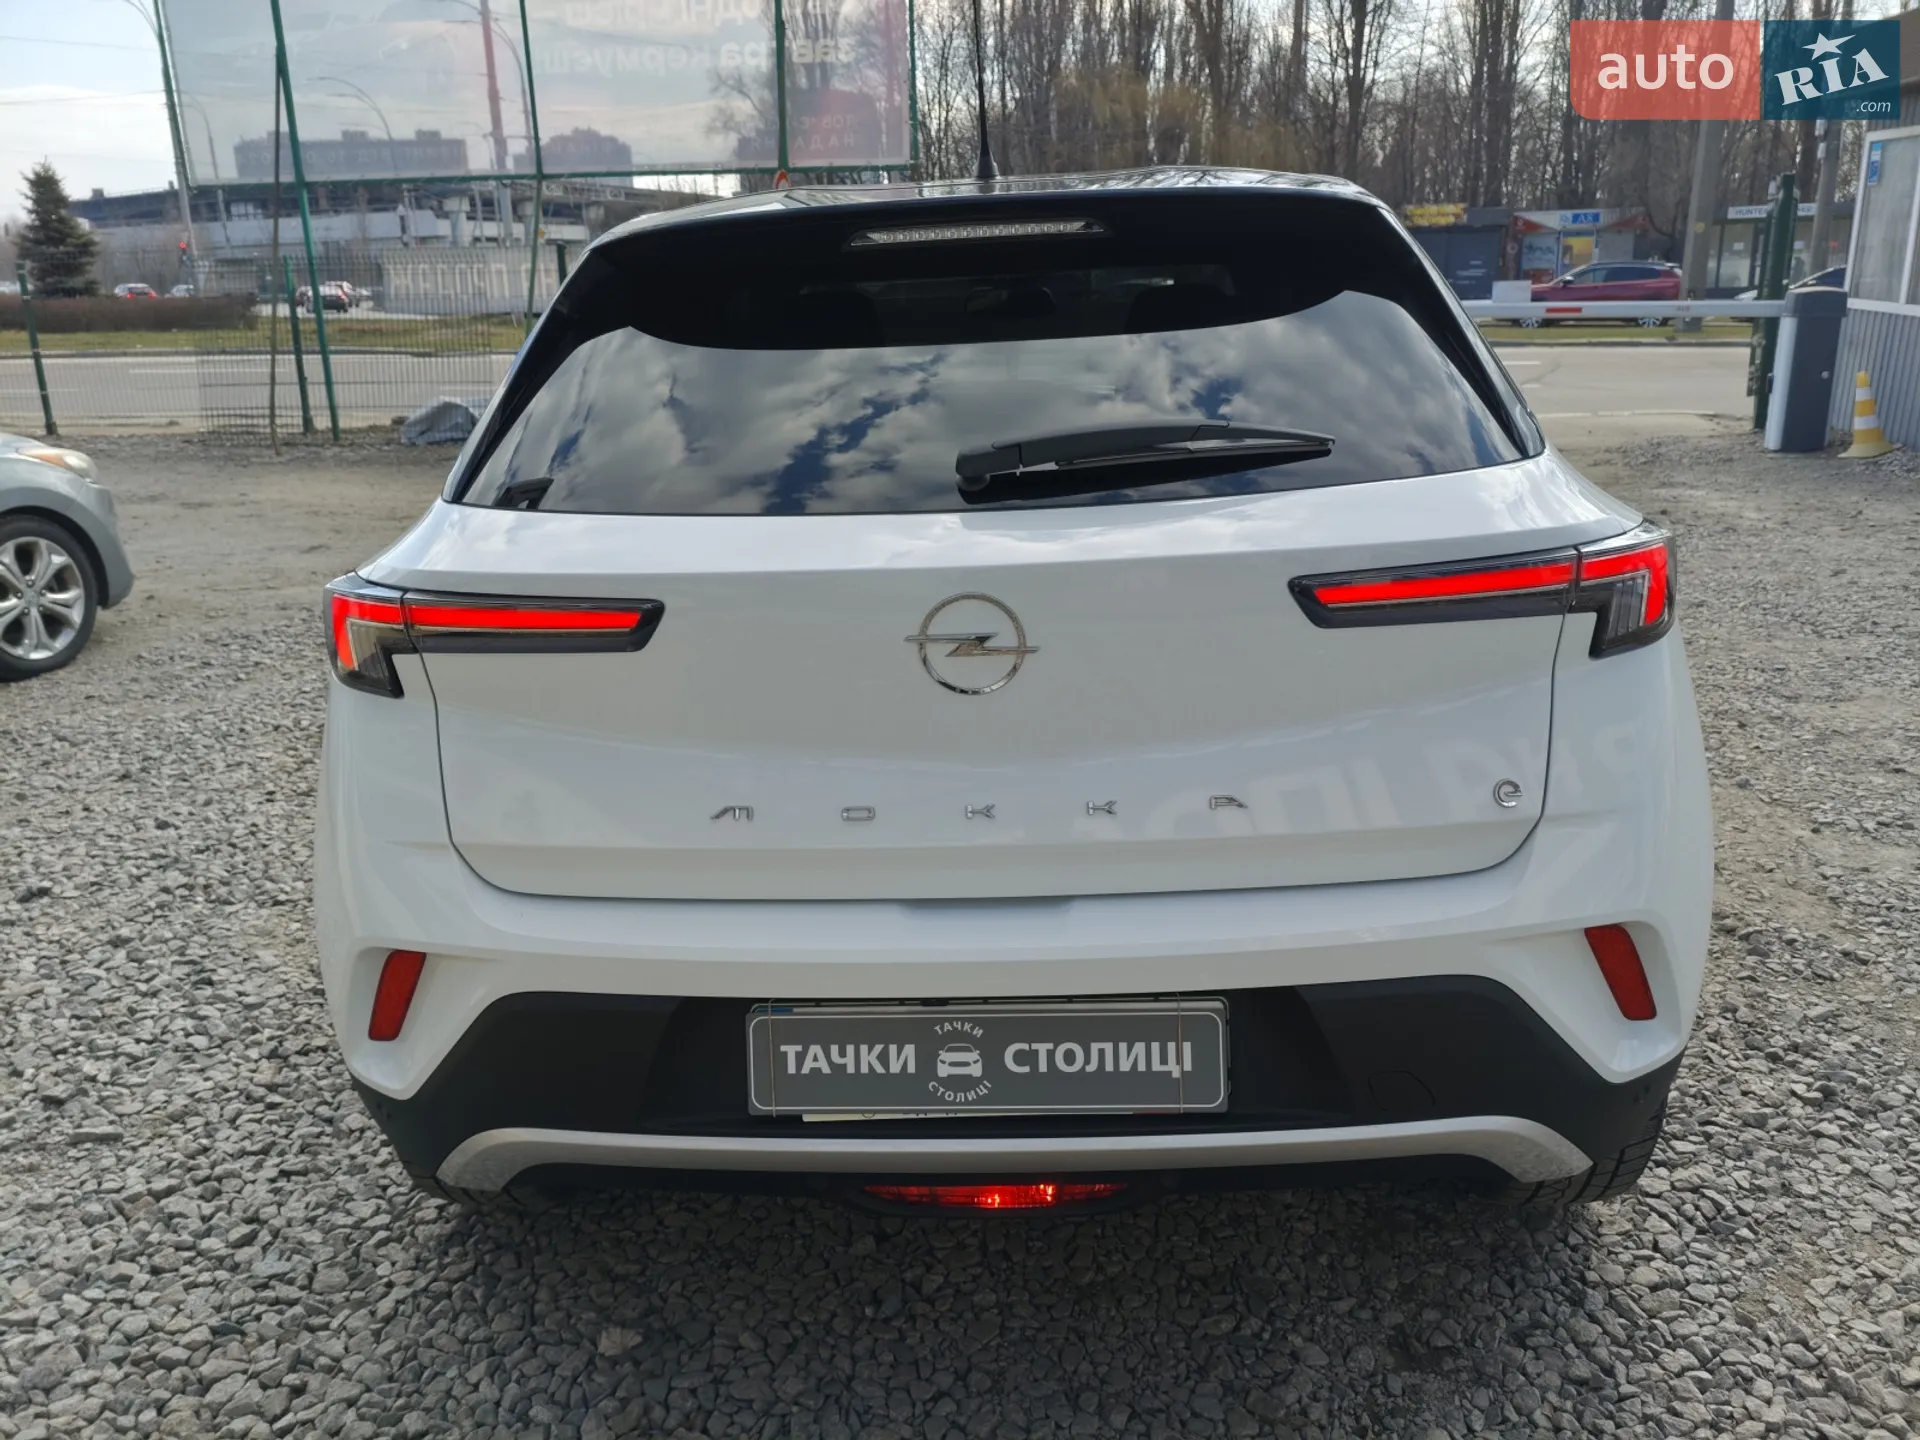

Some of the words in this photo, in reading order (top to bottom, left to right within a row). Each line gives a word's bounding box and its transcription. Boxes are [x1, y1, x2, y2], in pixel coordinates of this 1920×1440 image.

[709, 794, 1249, 823] MOKKA
[934, 1021, 983, 1038] ТАЧКИ
[780, 1044, 916, 1075] ТАЧКИ
[1004, 1041, 1192, 1078] СТОЛИЦІ
[928, 1080, 992, 1103] СТОЛИЦІ
